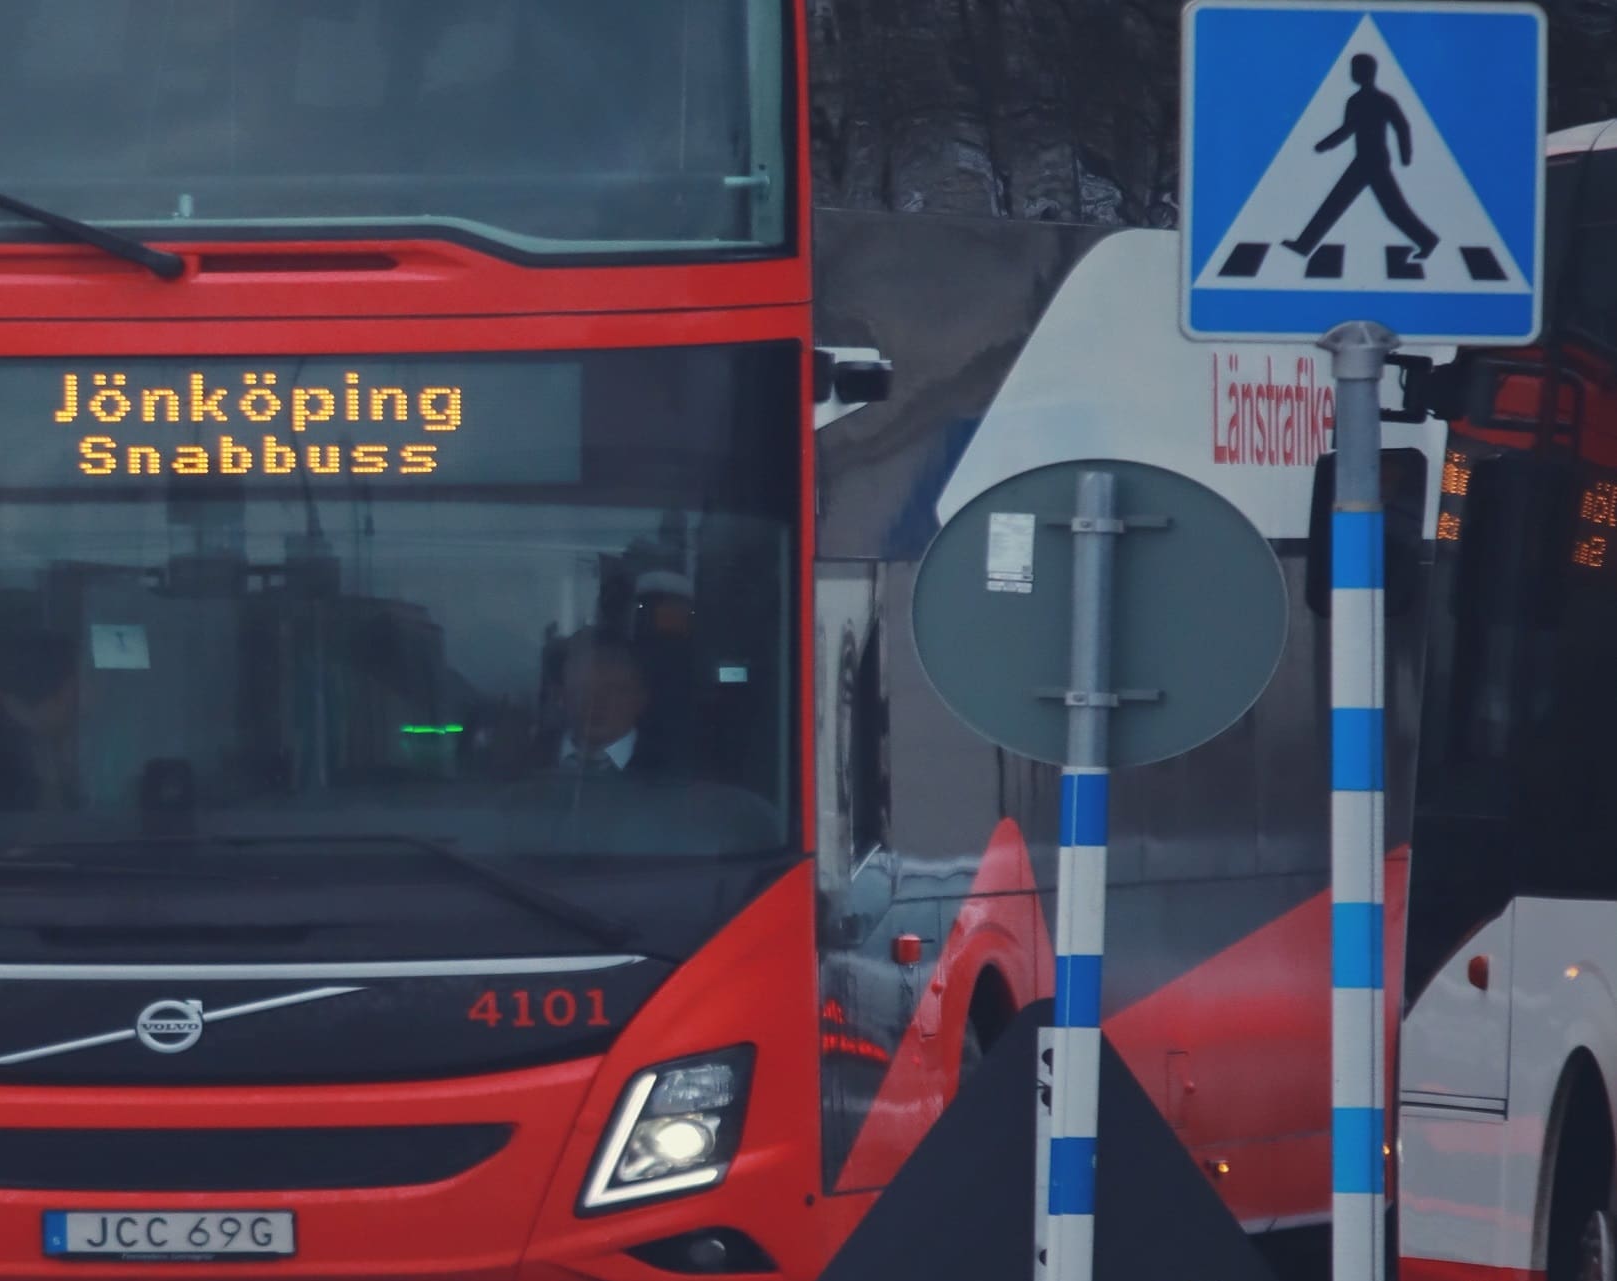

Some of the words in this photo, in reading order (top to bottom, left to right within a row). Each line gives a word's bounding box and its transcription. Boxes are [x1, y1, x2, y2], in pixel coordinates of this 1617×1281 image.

[54, 371, 462, 432] Jönköping
[79, 435, 438, 475] Snabbuss
[142, 1022, 200, 1032] VOLVO
[468, 988, 612, 1028] 4101
[85, 1216, 169, 1248] JCC
[187, 1216, 273, 1248] 69G
